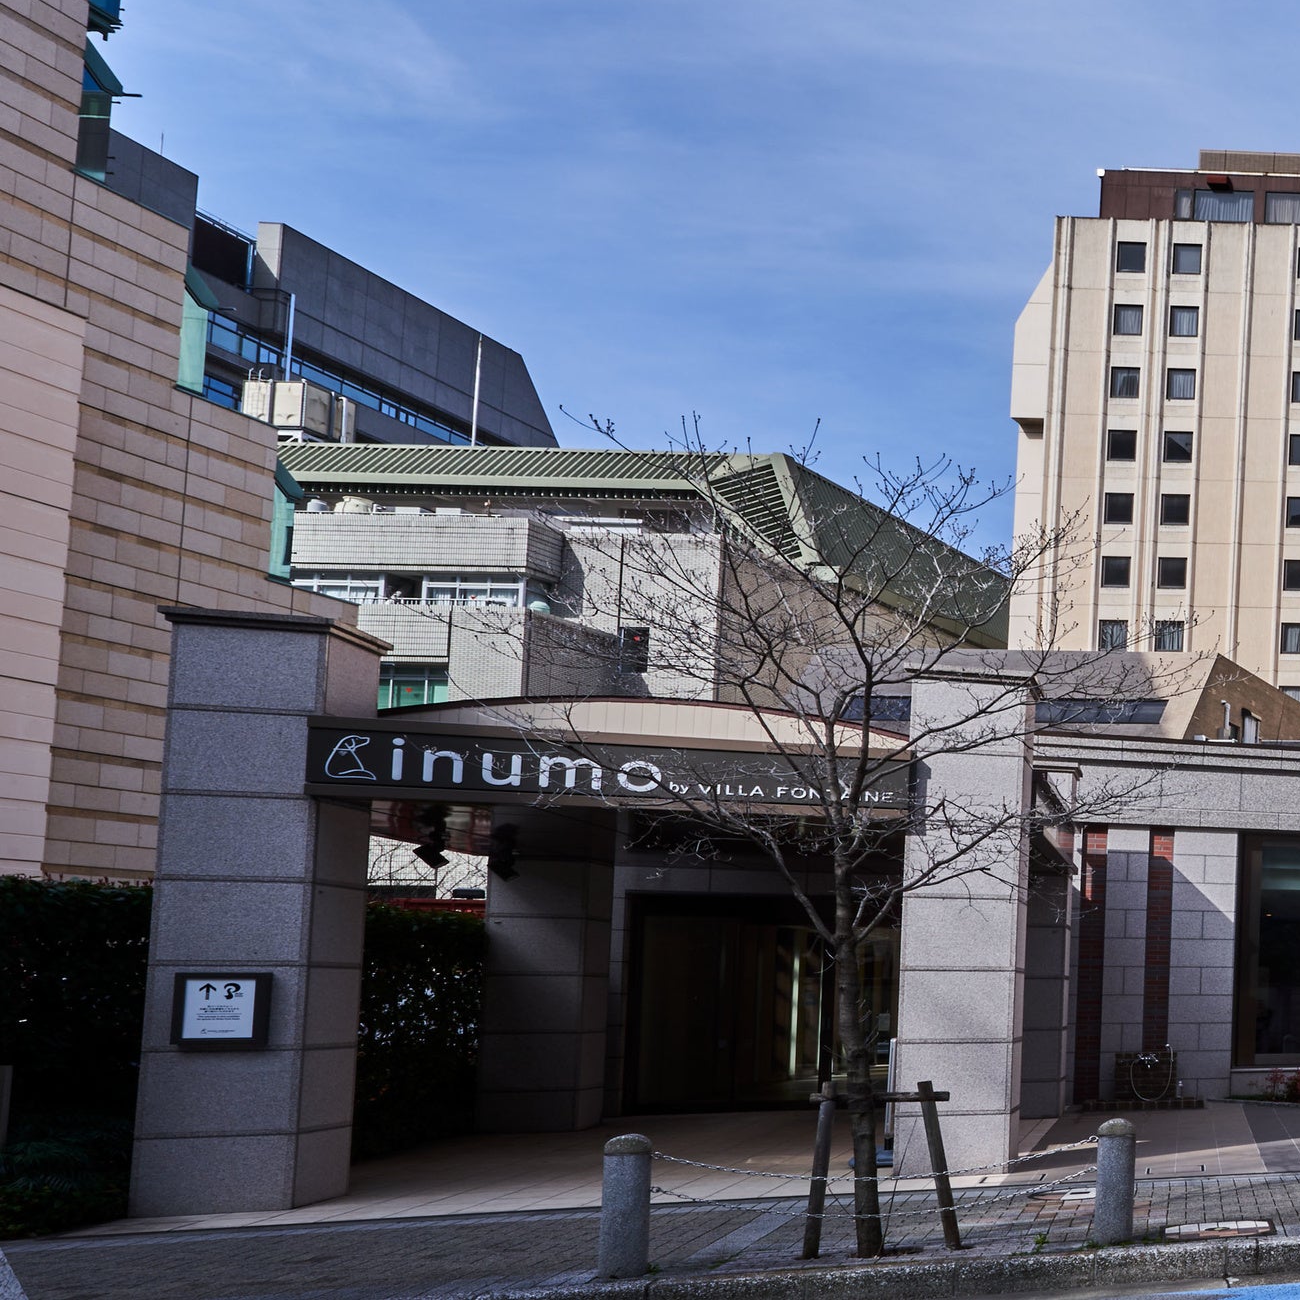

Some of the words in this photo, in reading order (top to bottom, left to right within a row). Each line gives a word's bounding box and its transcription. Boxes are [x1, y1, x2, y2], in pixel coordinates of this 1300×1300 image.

[391, 737, 662, 792] inumo
[669, 781, 689, 795] by
[698, 783, 765, 798] VILLA
